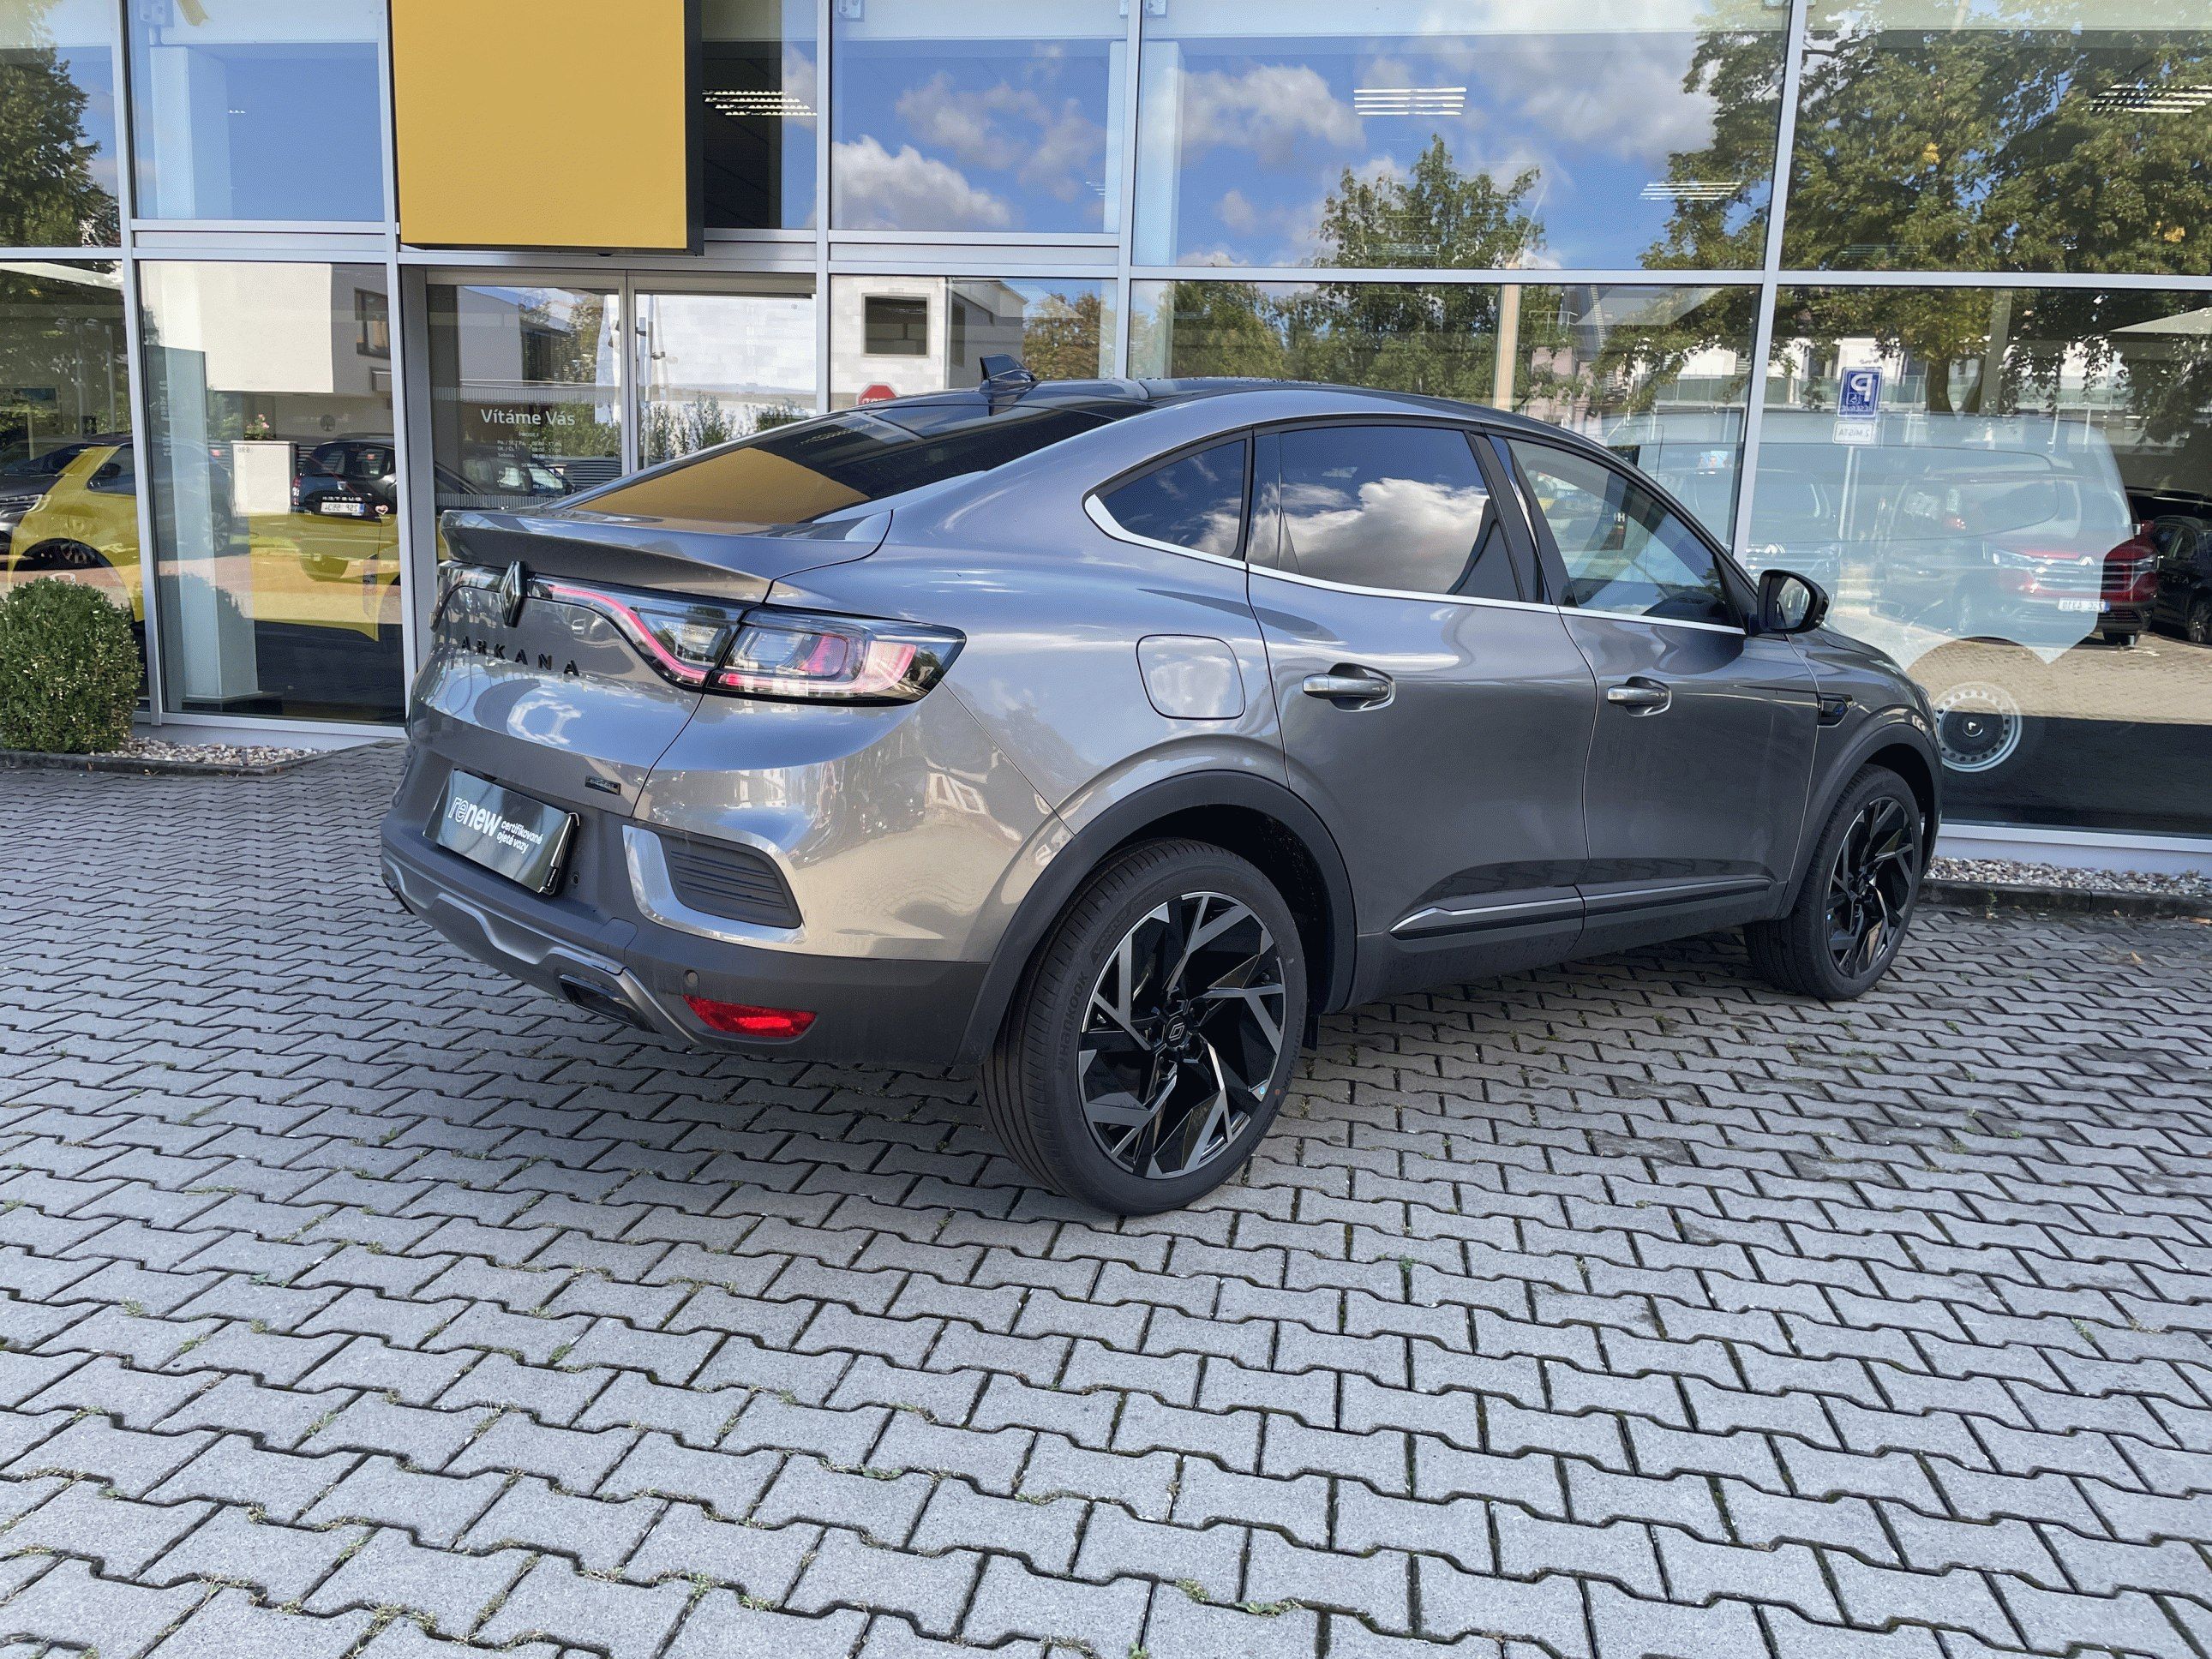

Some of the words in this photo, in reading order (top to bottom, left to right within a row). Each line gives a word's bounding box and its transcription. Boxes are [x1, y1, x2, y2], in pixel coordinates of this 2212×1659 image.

[481, 409, 541, 424] Vítáme
[546, 410, 575, 425] Vás
[461, 636, 580, 676] ARKANA
[447, 796, 502, 836] renew
[496, 831, 513, 846] ojeté
[513, 838, 530, 853] vozy
[501, 820, 543, 845] certifikované
